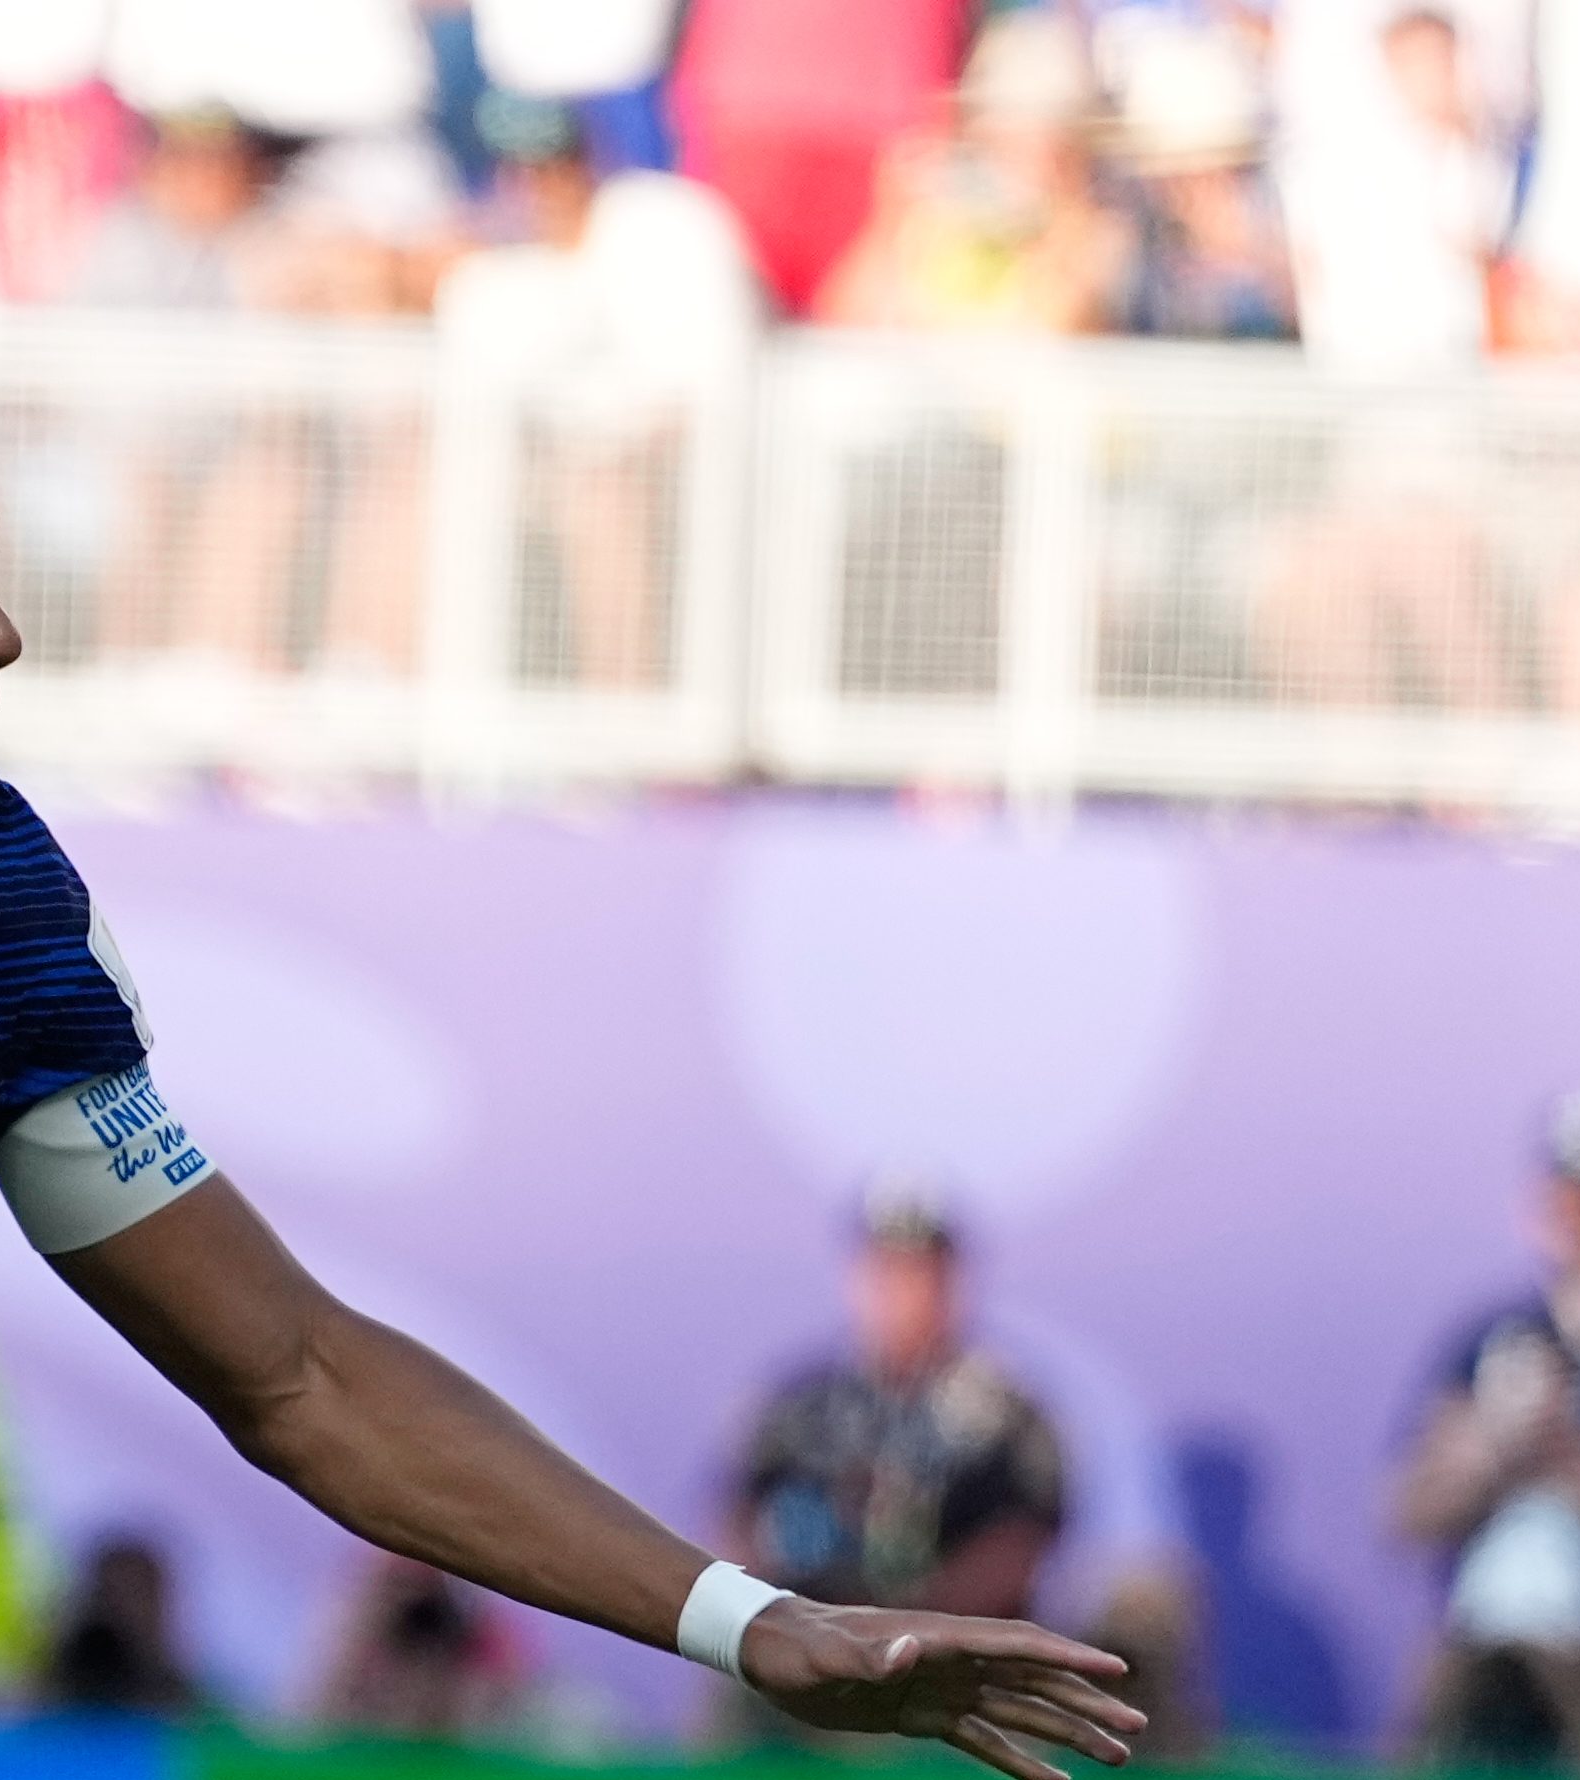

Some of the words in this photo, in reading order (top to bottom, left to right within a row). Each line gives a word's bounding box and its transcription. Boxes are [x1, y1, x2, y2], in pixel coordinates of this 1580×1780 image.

[90, 1081, 167, 1149] UNITE
[107, 1147, 156, 1183] the
[168, 1149, 204, 1182] FIFA
